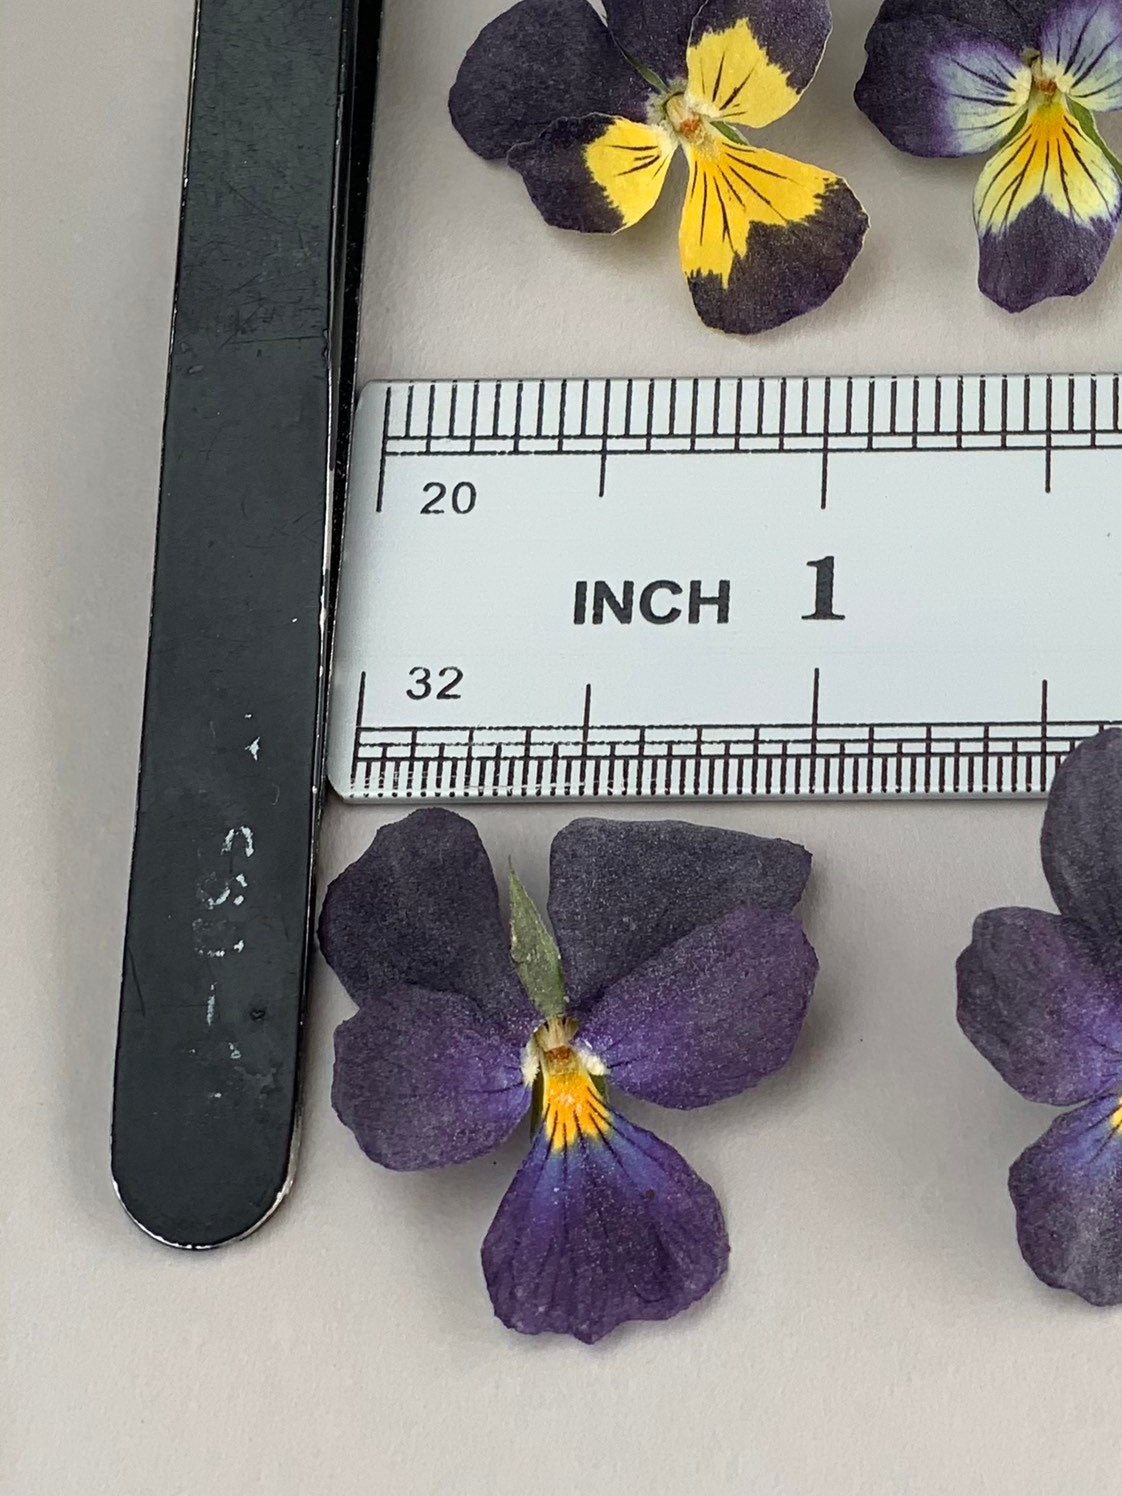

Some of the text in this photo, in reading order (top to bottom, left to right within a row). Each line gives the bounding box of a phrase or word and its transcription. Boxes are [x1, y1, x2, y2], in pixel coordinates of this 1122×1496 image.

[419, 481, 477, 515] 20
[573, 579, 731, 625] INCH
[801, 555, 846, 621] 1
[405, 666, 464, 701] 32
